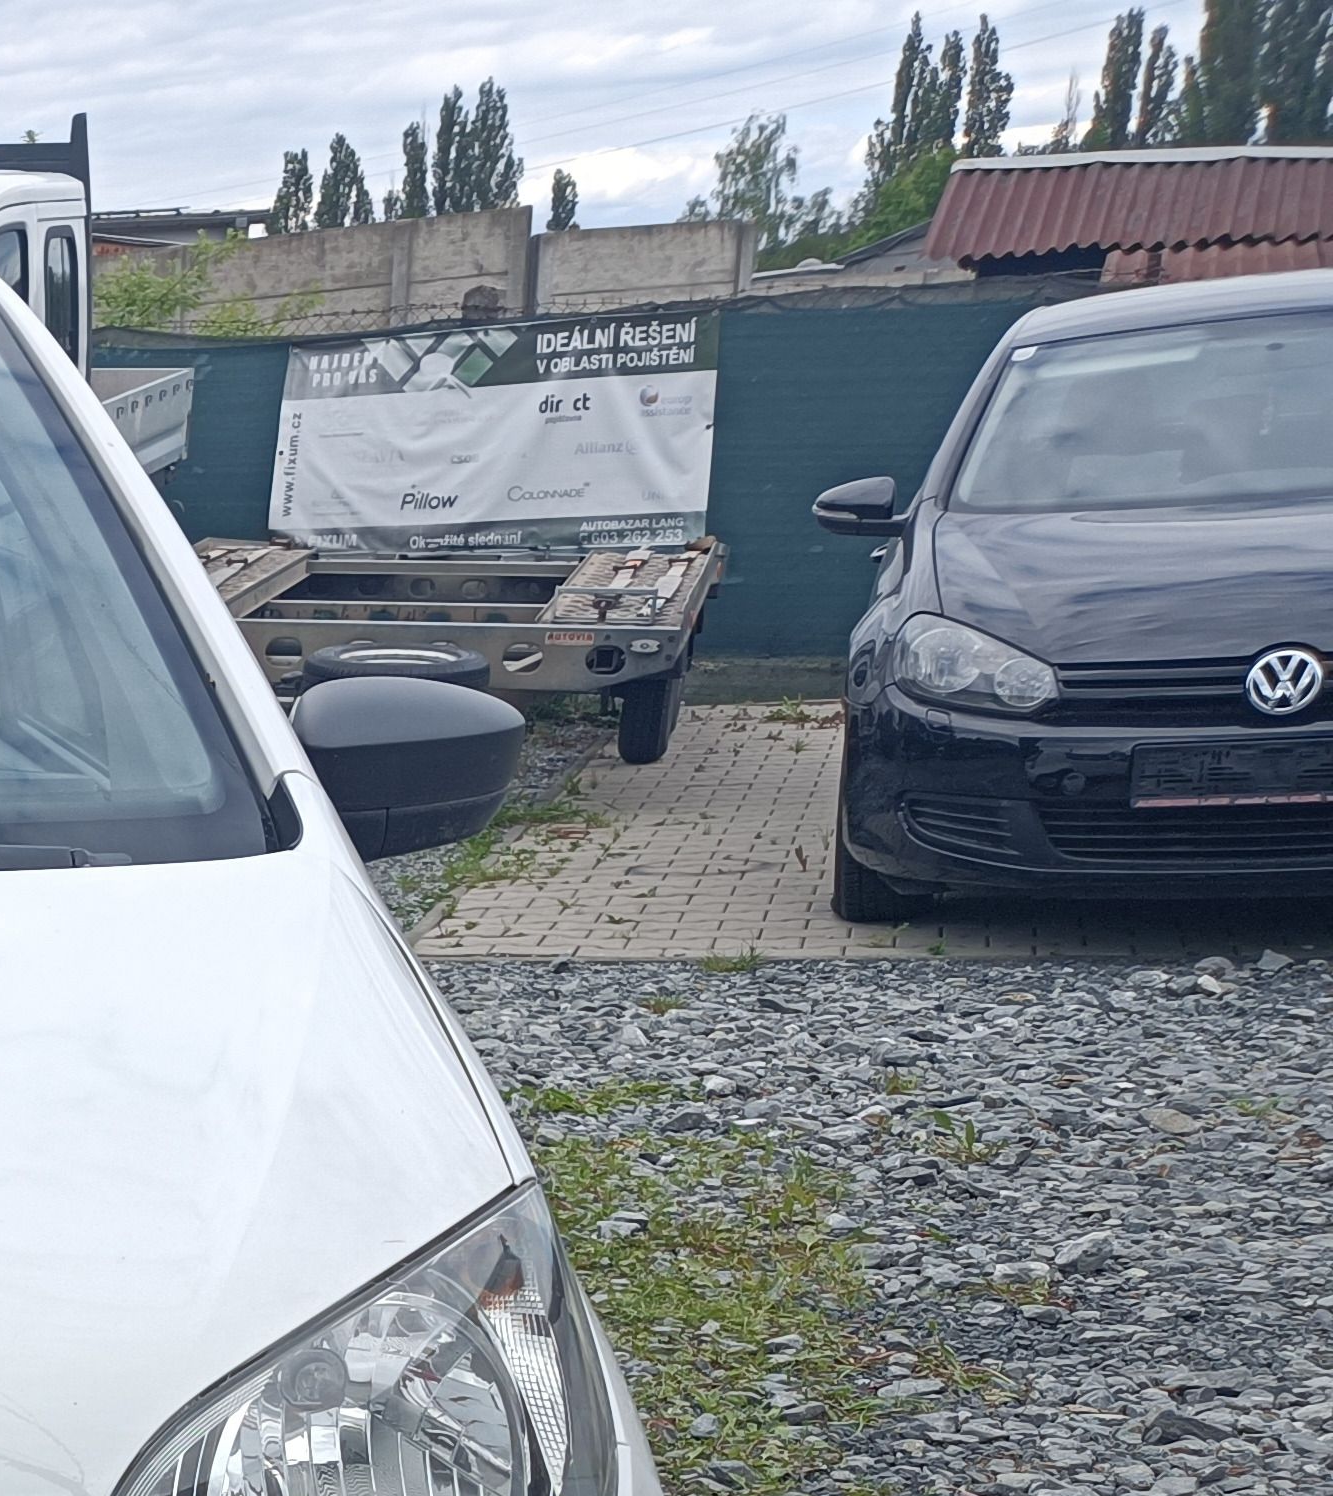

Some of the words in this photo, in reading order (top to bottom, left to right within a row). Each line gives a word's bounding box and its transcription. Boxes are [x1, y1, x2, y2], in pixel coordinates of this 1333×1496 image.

[536, 323, 616, 354] IDEÁLNÍ
[619, 317, 698, 347] ŘEŠENÍ
[536, 359, 548, 374] V
[550, 353, 613, 374] OBLASTI
[616, 344, 696, 368] POJIŠTĚNÍ
[400, 491, 459, 510] Pillow
[580, 519, 650, 531] AUTOBAZAR
[652, 517, 684, 528] LANG
[622, 530, 651, 544] 262
[655, 528, 684, 542] 253
